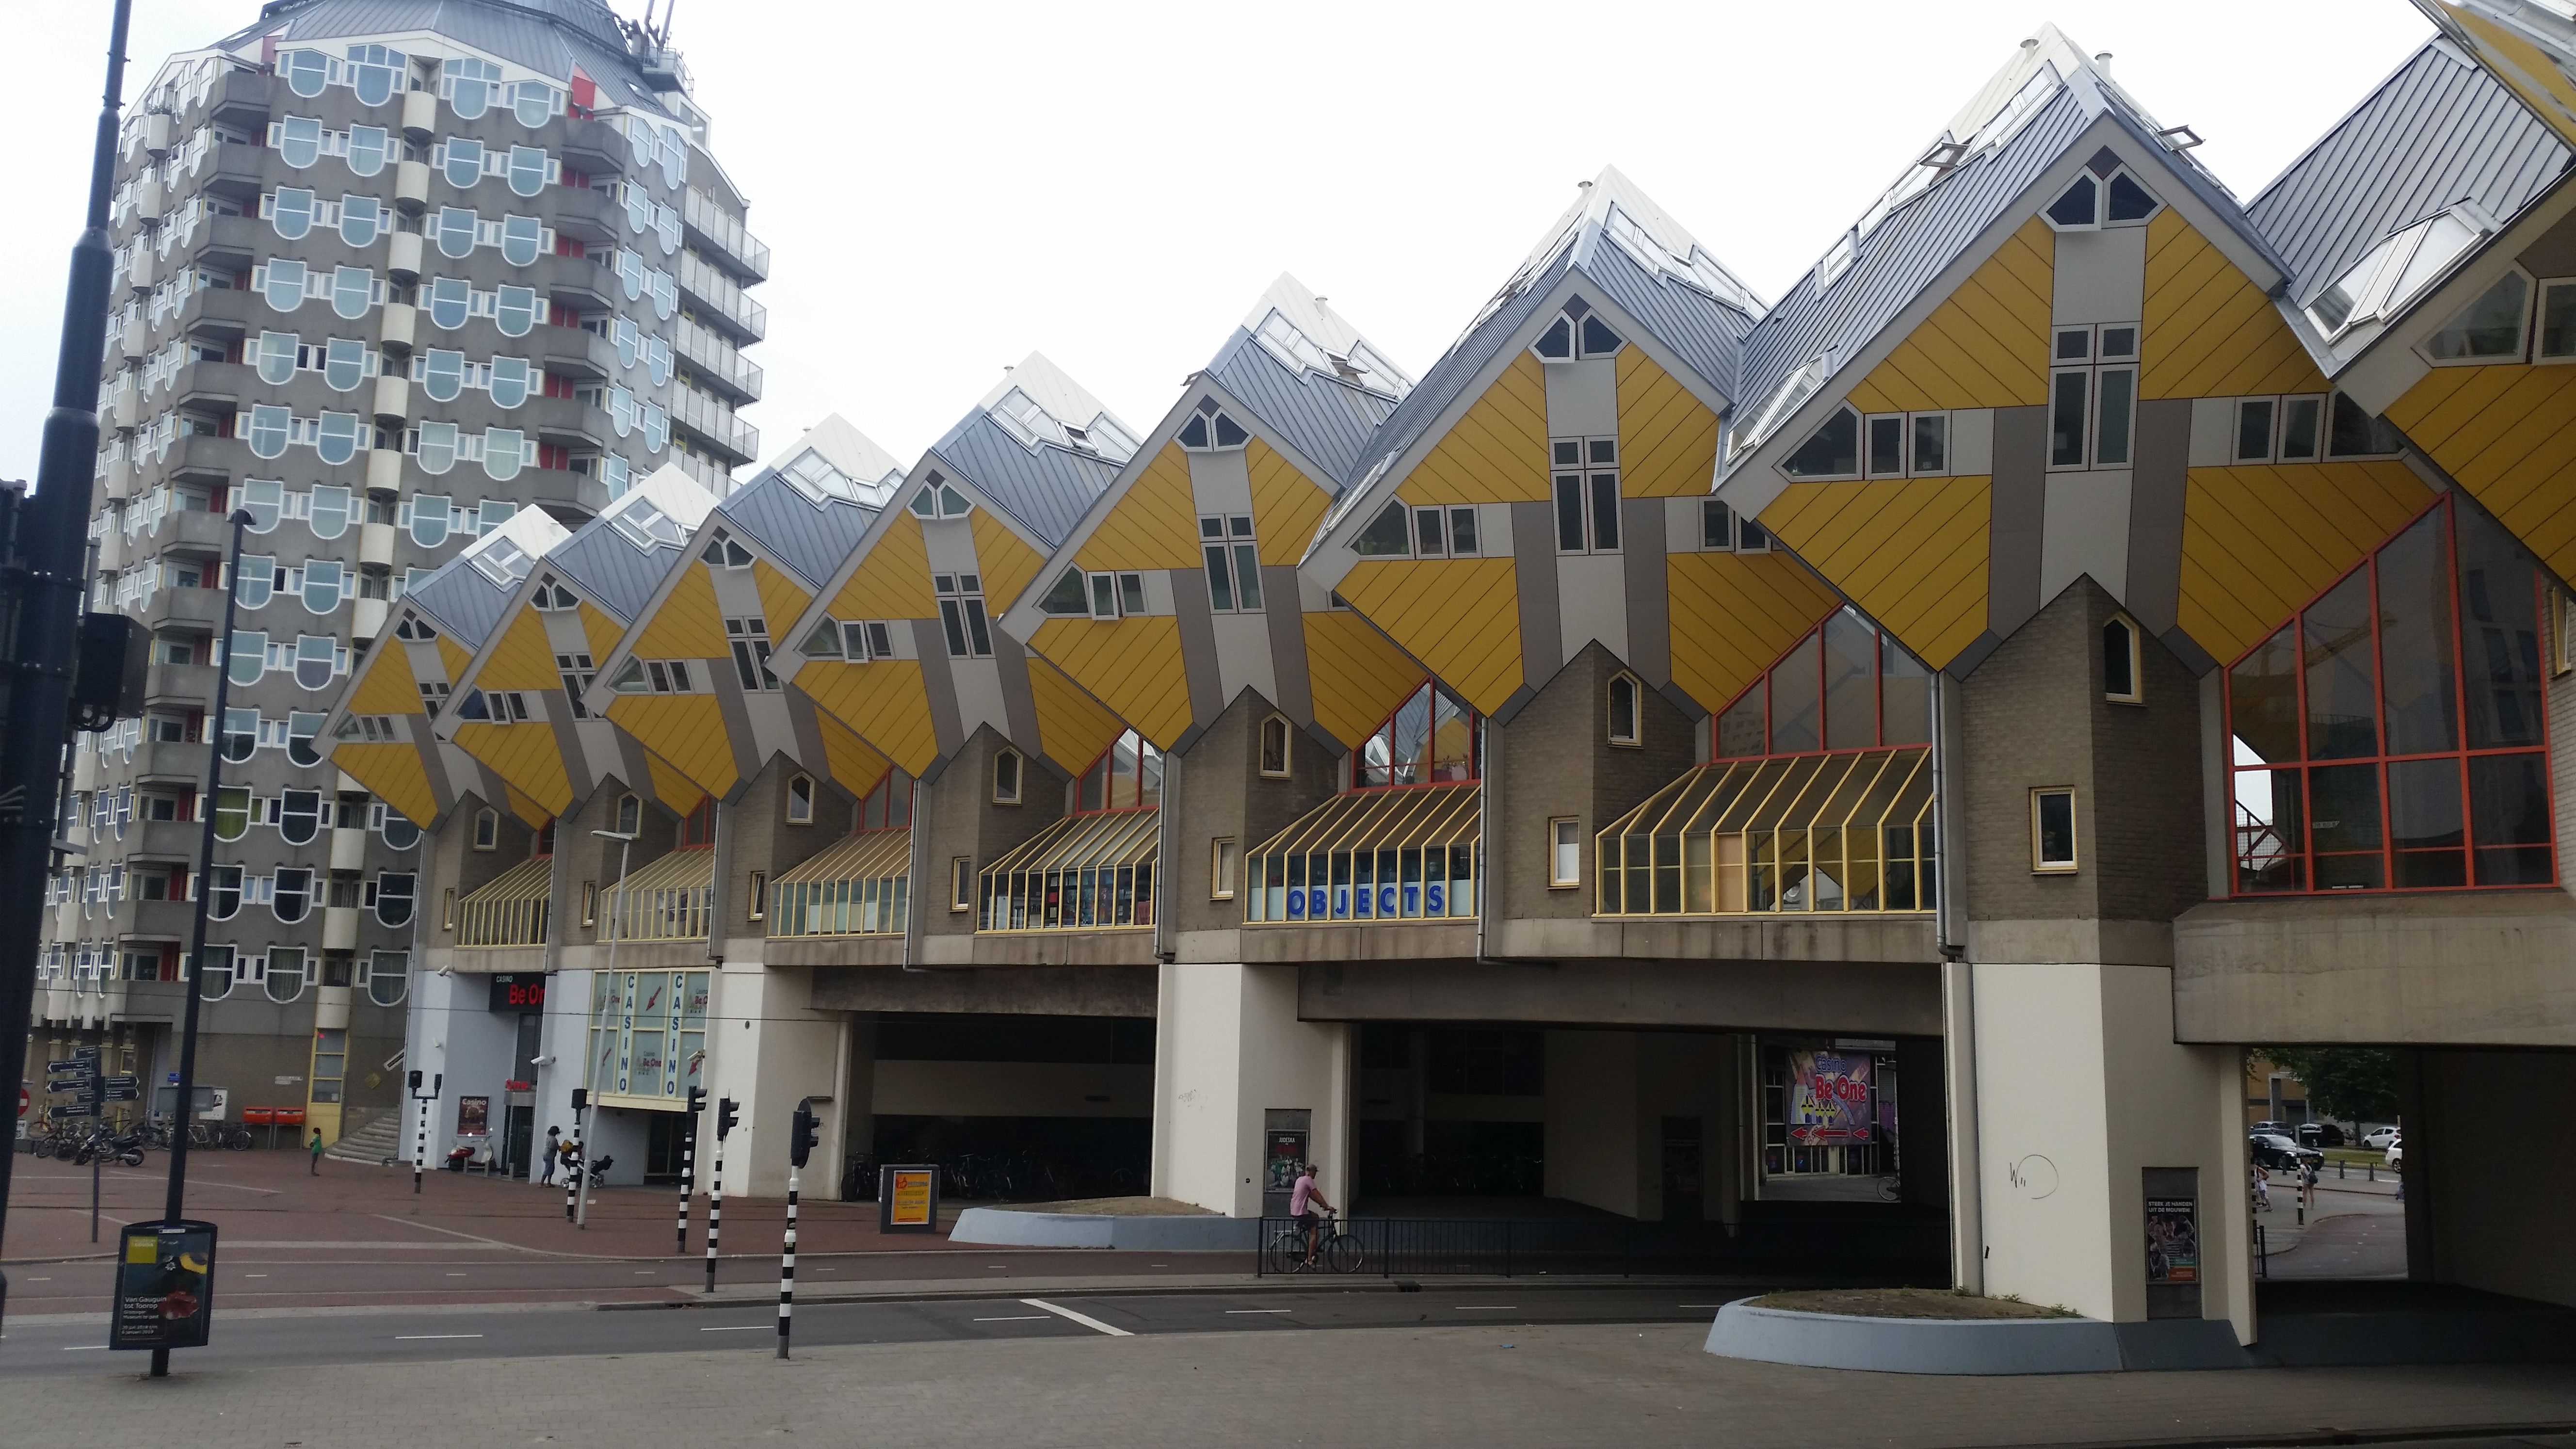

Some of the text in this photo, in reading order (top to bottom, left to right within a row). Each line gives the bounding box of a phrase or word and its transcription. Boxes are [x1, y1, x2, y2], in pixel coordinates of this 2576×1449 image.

[1288, 886, 1443, 915] OBJECTS
[509, 984, 526, 1005] Be
[620, 975, 634, 1091] CASINO
[667, 975, 682, 1095] CASINO
[1816, 1055, 1847, 1073] Casino
[1816, 1073, 1867, 1102] Be One
